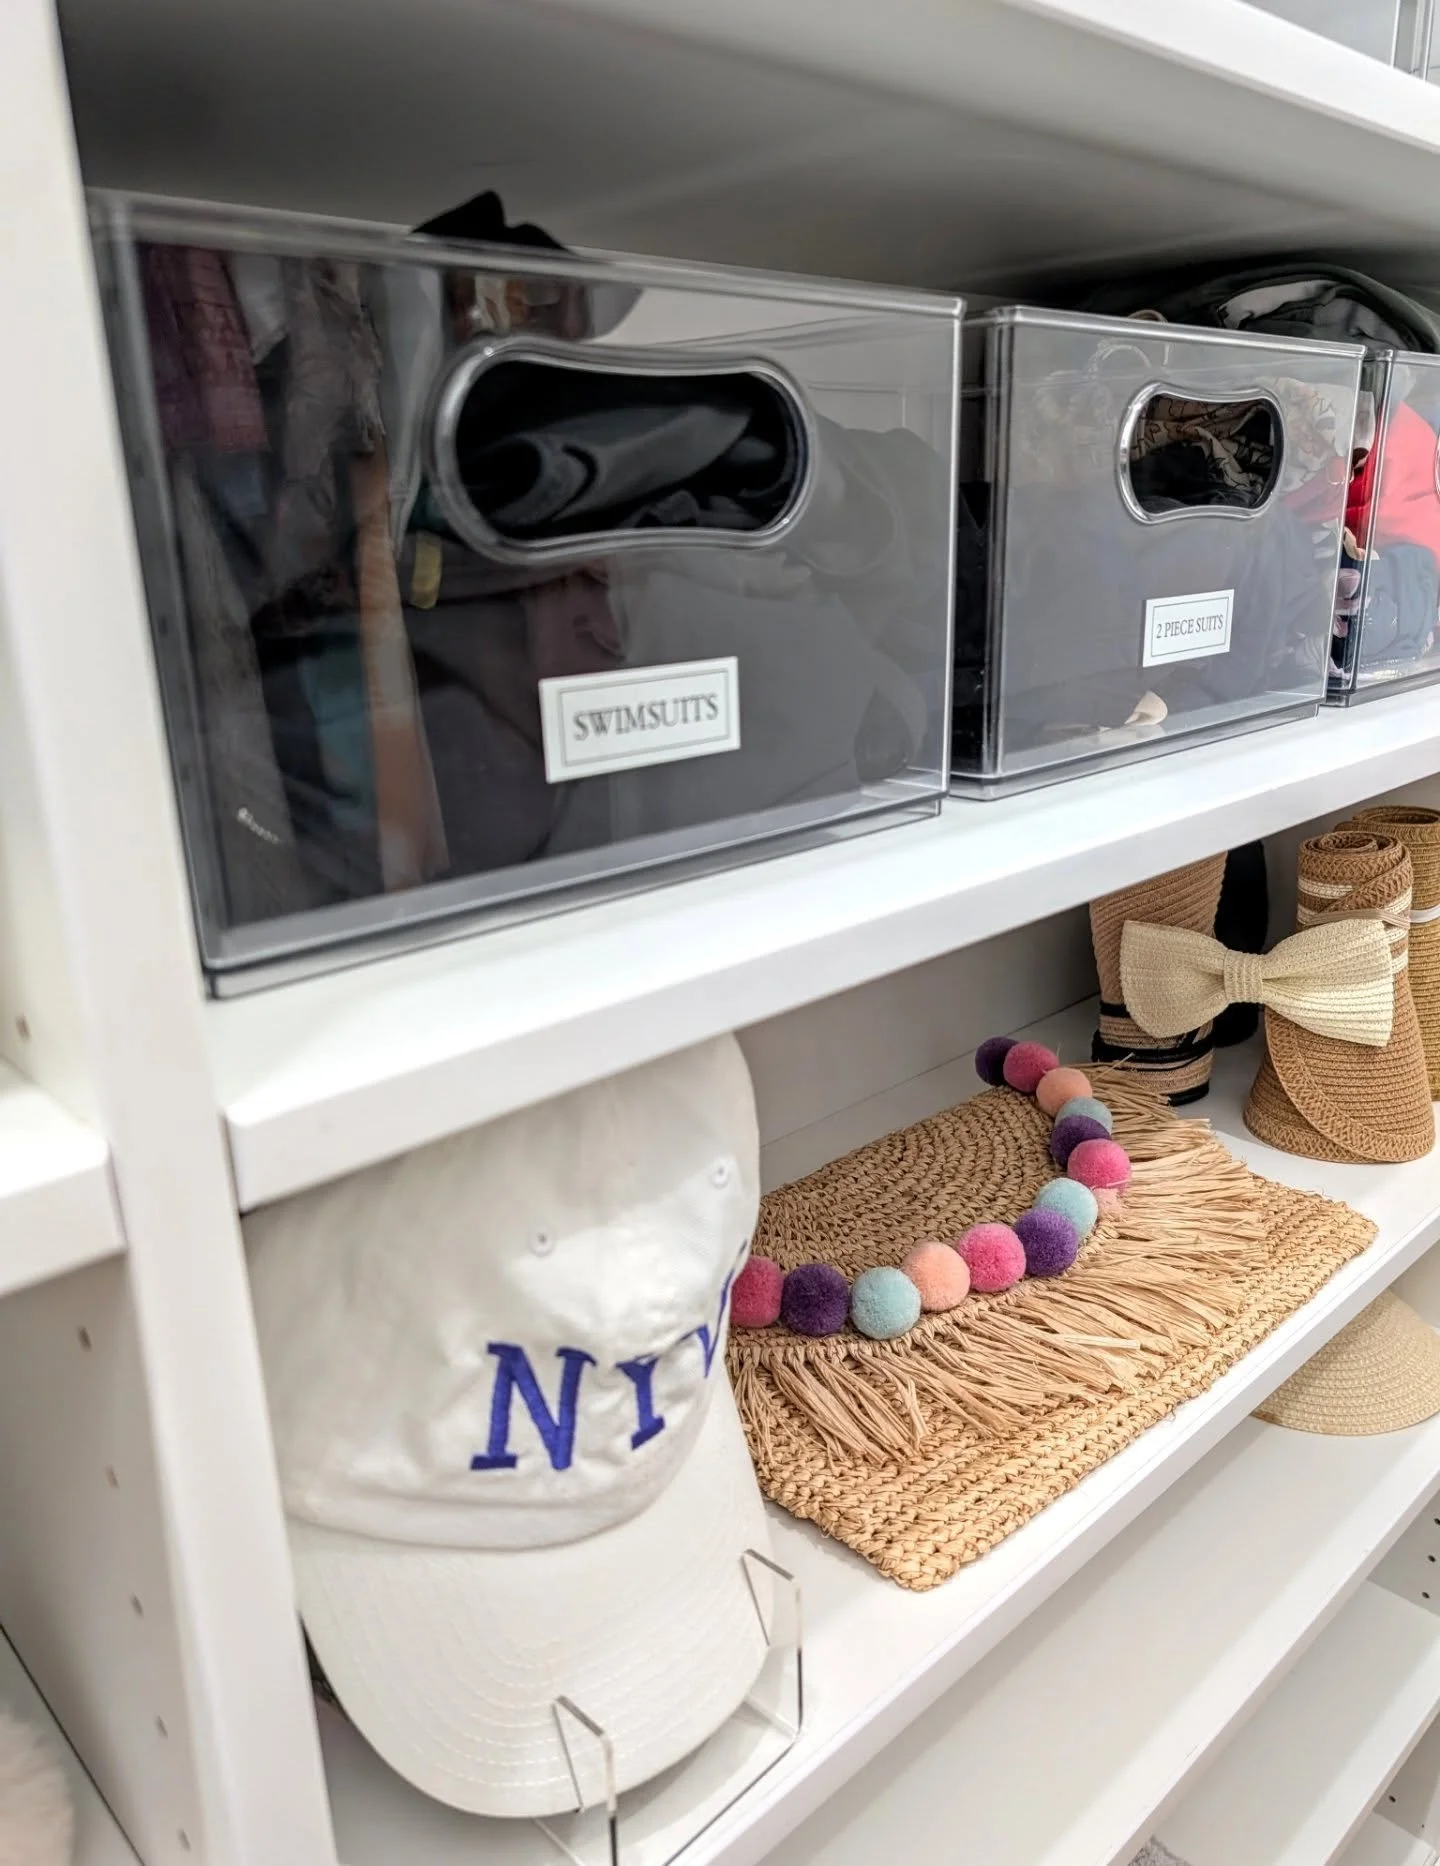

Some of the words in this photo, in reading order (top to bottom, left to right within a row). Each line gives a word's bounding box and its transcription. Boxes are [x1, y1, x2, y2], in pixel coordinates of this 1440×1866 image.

[1156, 623, 1163, 639] 2
[1164, 618, 1194, 638] PIECE
[1195, 614, 1224, 633] SUITS
[573, 692, 719, 742] SWIMSUITS
